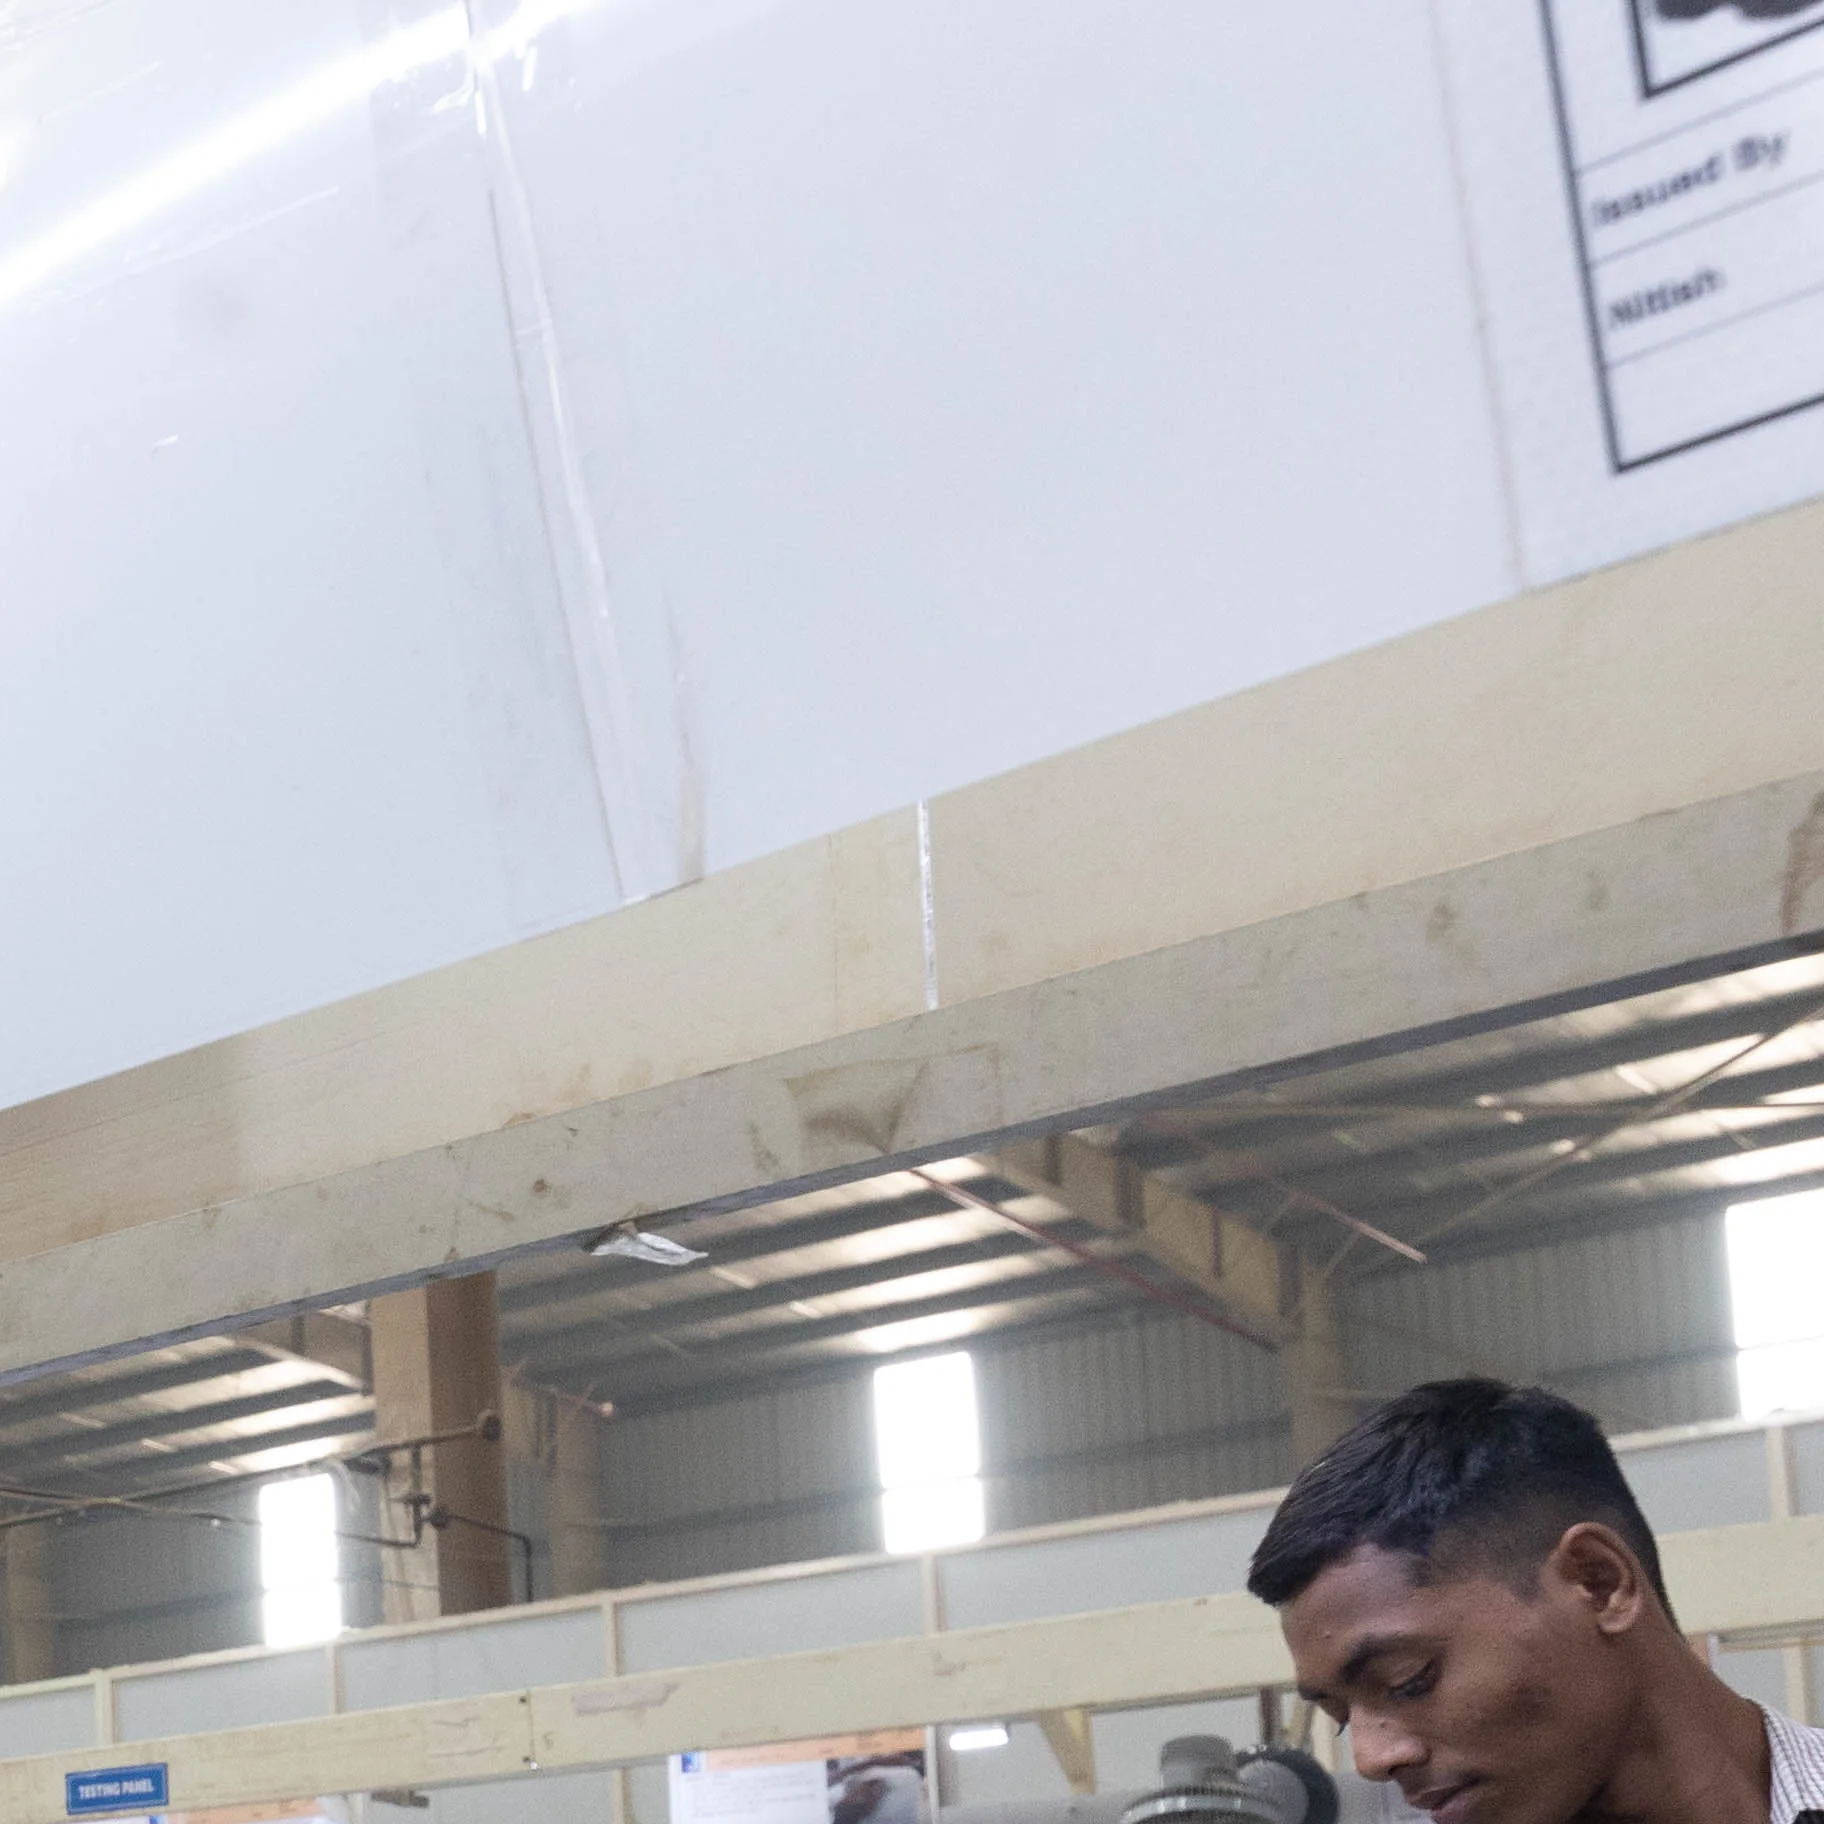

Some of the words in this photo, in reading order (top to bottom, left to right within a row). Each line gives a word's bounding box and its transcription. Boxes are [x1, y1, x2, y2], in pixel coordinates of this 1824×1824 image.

[1596, 154, 1722, 225] Issued
[1734, 132, 1789, 172] By
[79, 1782, 120, 1799] TESTING
[123, 1778, 155, 1794] PANEL
